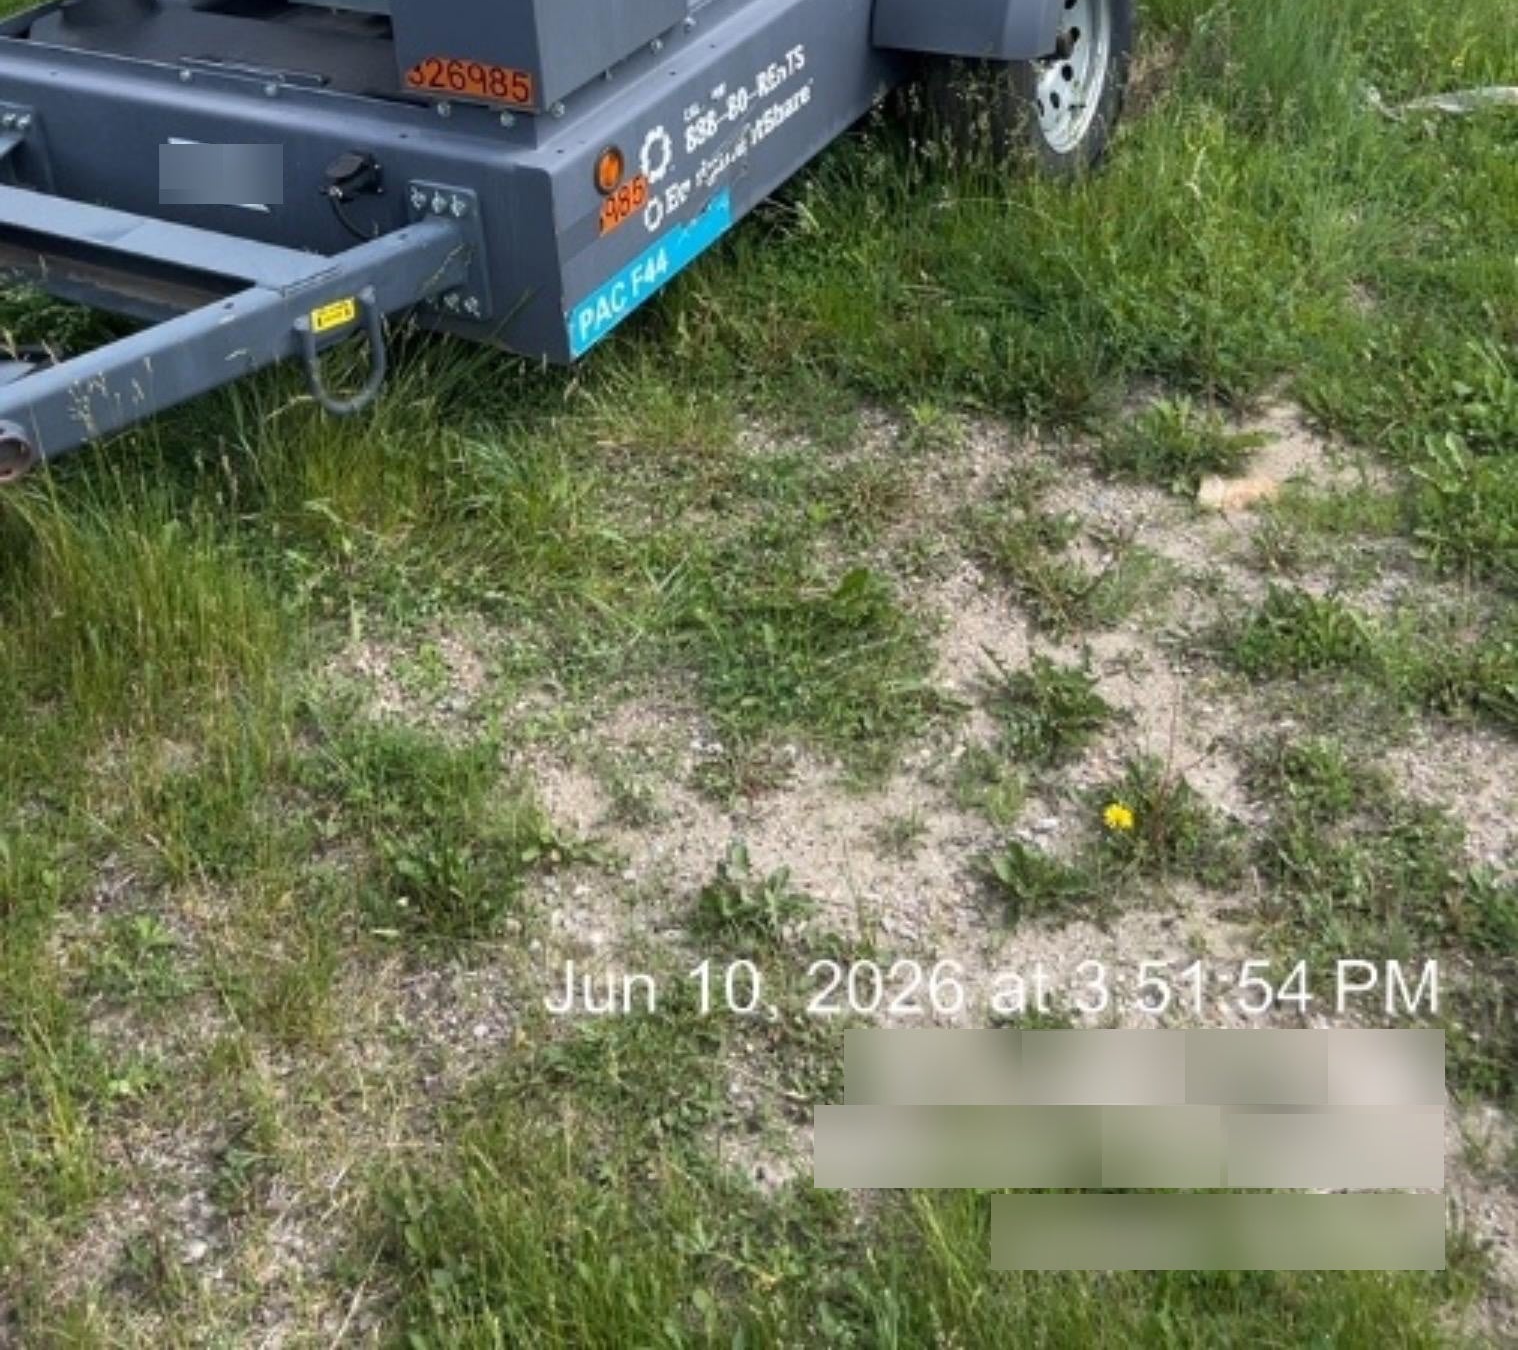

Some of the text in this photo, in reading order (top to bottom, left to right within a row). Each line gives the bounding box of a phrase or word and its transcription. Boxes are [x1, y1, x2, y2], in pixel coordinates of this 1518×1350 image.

[599, 176, 643, 231] 985
[578, 247, 668, 341] PAC F44
